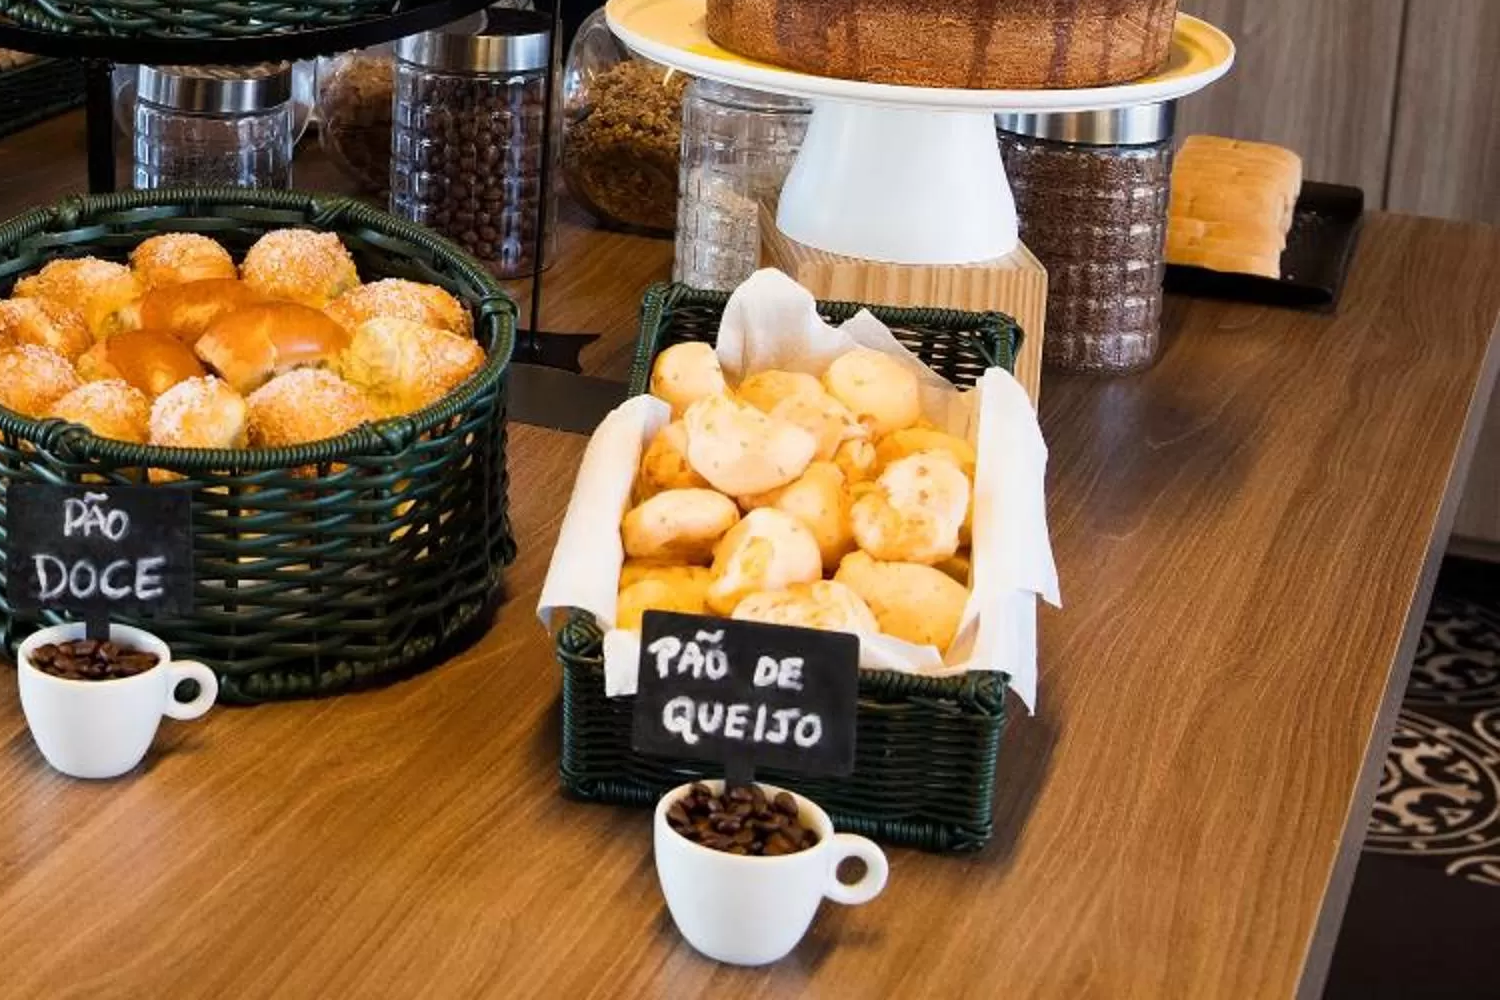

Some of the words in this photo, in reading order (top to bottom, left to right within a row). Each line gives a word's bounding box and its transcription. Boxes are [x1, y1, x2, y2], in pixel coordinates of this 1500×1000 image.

[63, 491, 129, 542] PÃO
[31, 553, 166, 600] DOCE
[753, 655, 805, 691] DE
[662, 695, 823, 748] QUEIJO
